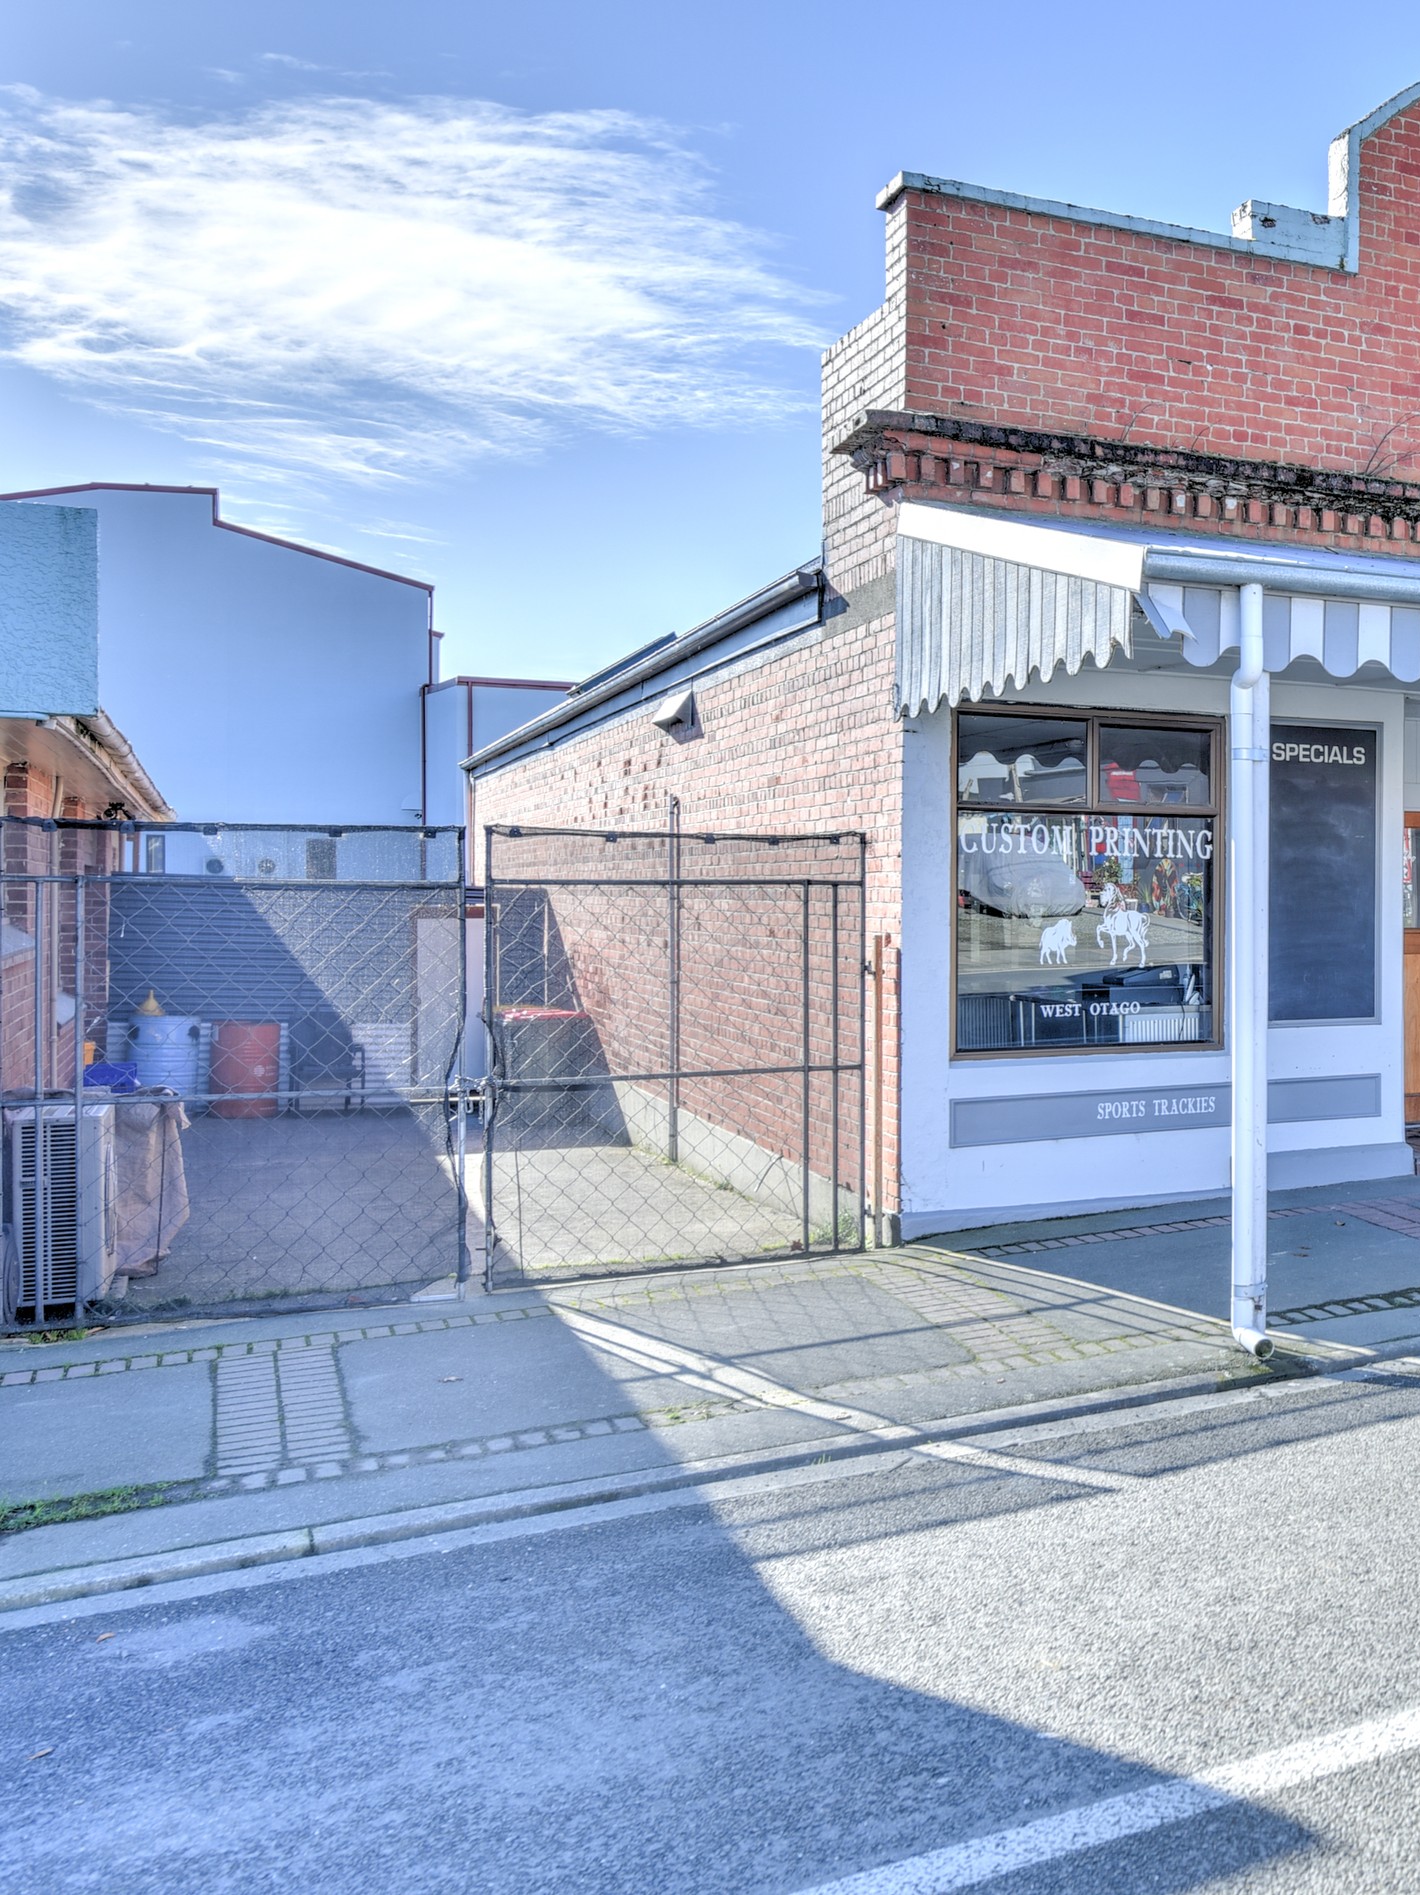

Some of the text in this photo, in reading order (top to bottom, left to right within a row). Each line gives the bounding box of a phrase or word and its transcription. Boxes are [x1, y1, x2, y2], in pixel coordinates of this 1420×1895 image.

[1272, 742, 1366, 765] SPECIALS
[959, 820, 1213, 860] CUSTOM PRINTING
[1040, 1001, 1141, 1018] WEST OTAGO
[1097, 1096, 1216, 1120] SPORTS TRACKIES
